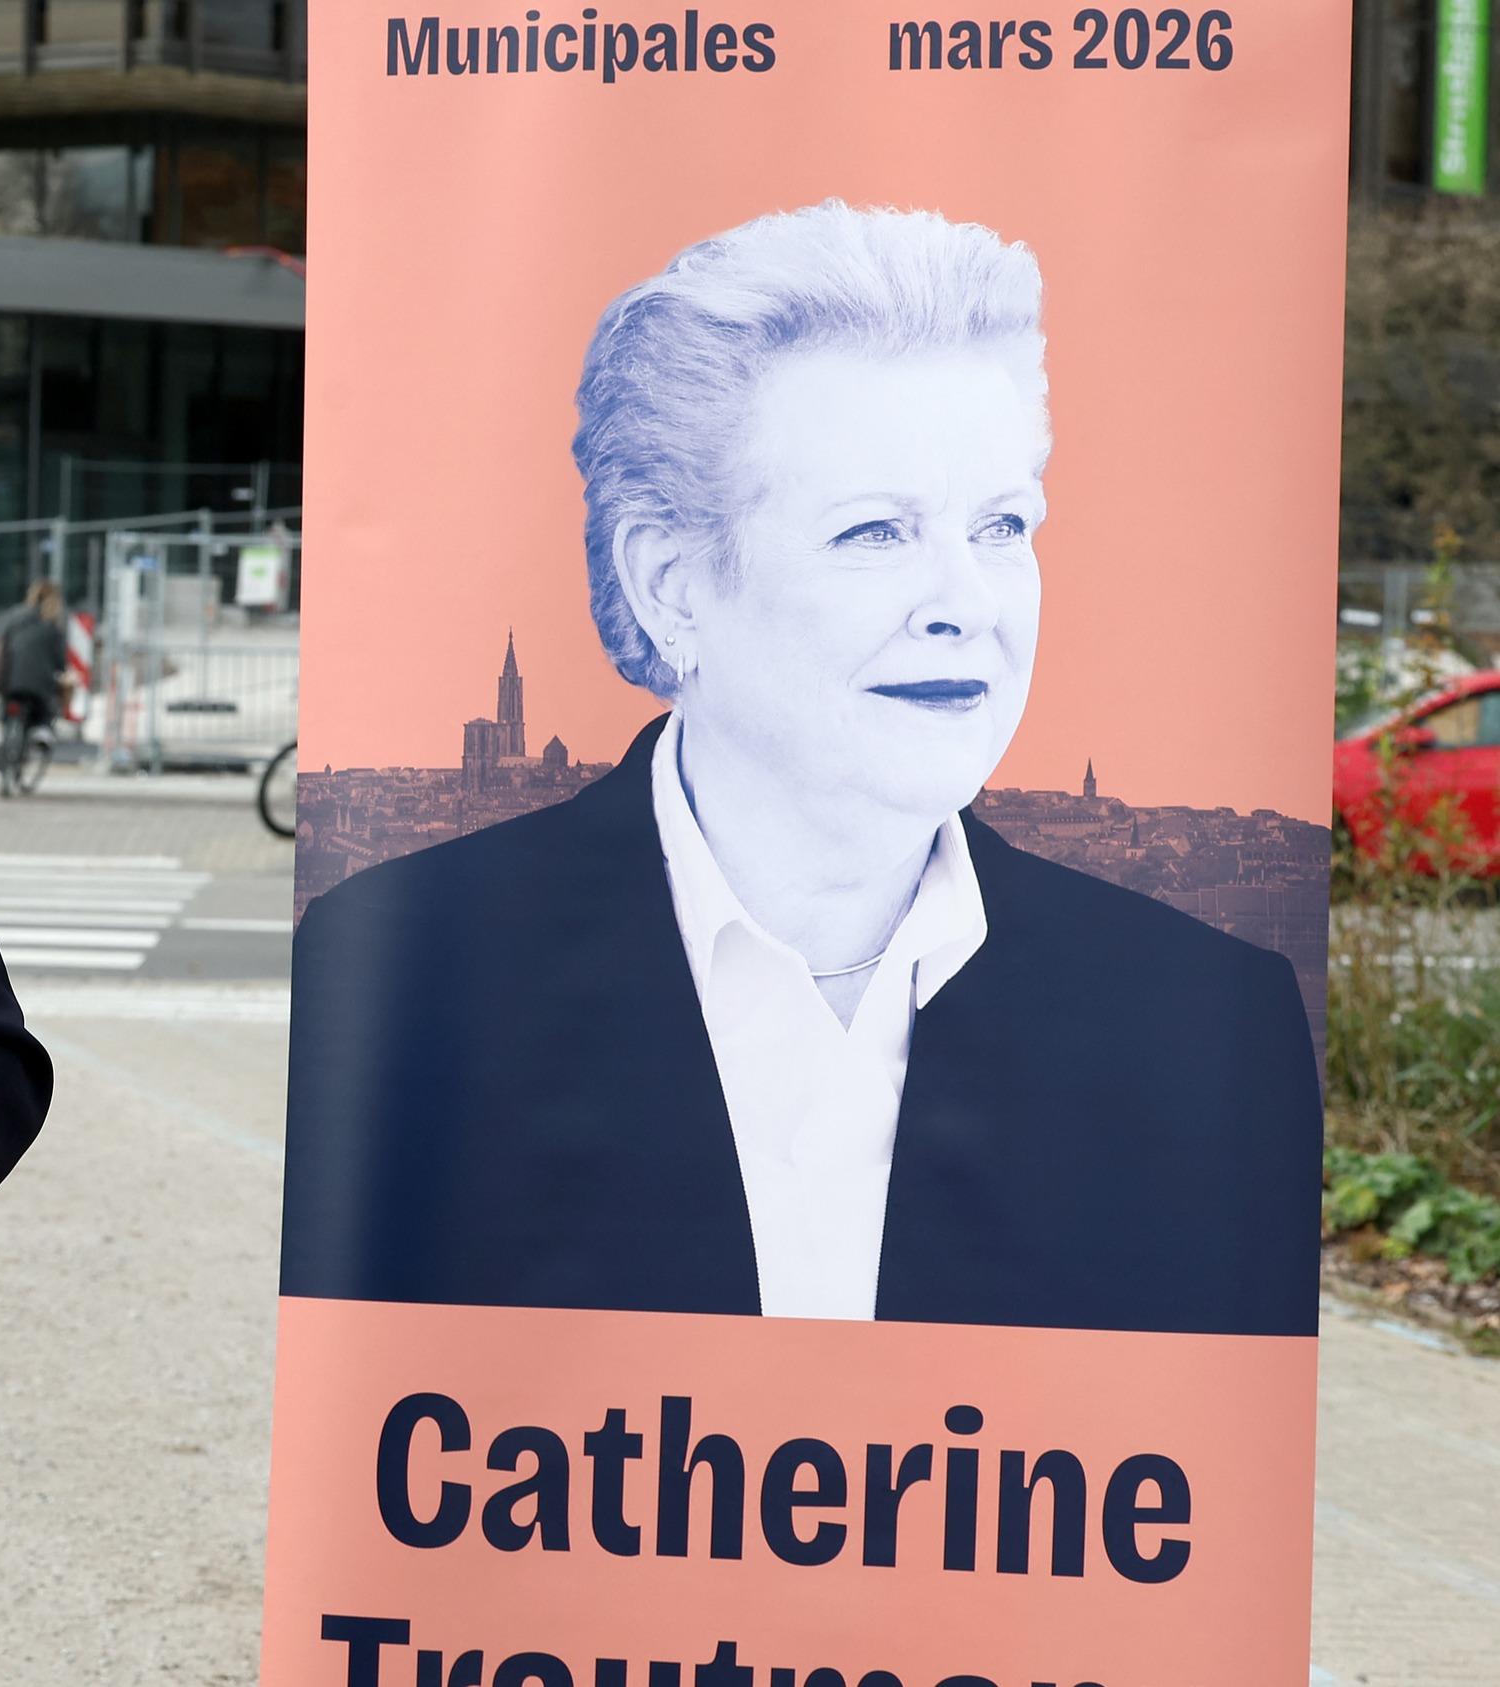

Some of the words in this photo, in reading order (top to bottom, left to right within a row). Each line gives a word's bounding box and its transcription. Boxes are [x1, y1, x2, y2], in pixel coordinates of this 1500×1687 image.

[386, 8, 776, 84] Municipales
[889, 20, 1053, 71] mars
[1073, 8, 1234, 72] 2026
[376, 1392, 1192, 1584] Catherine
